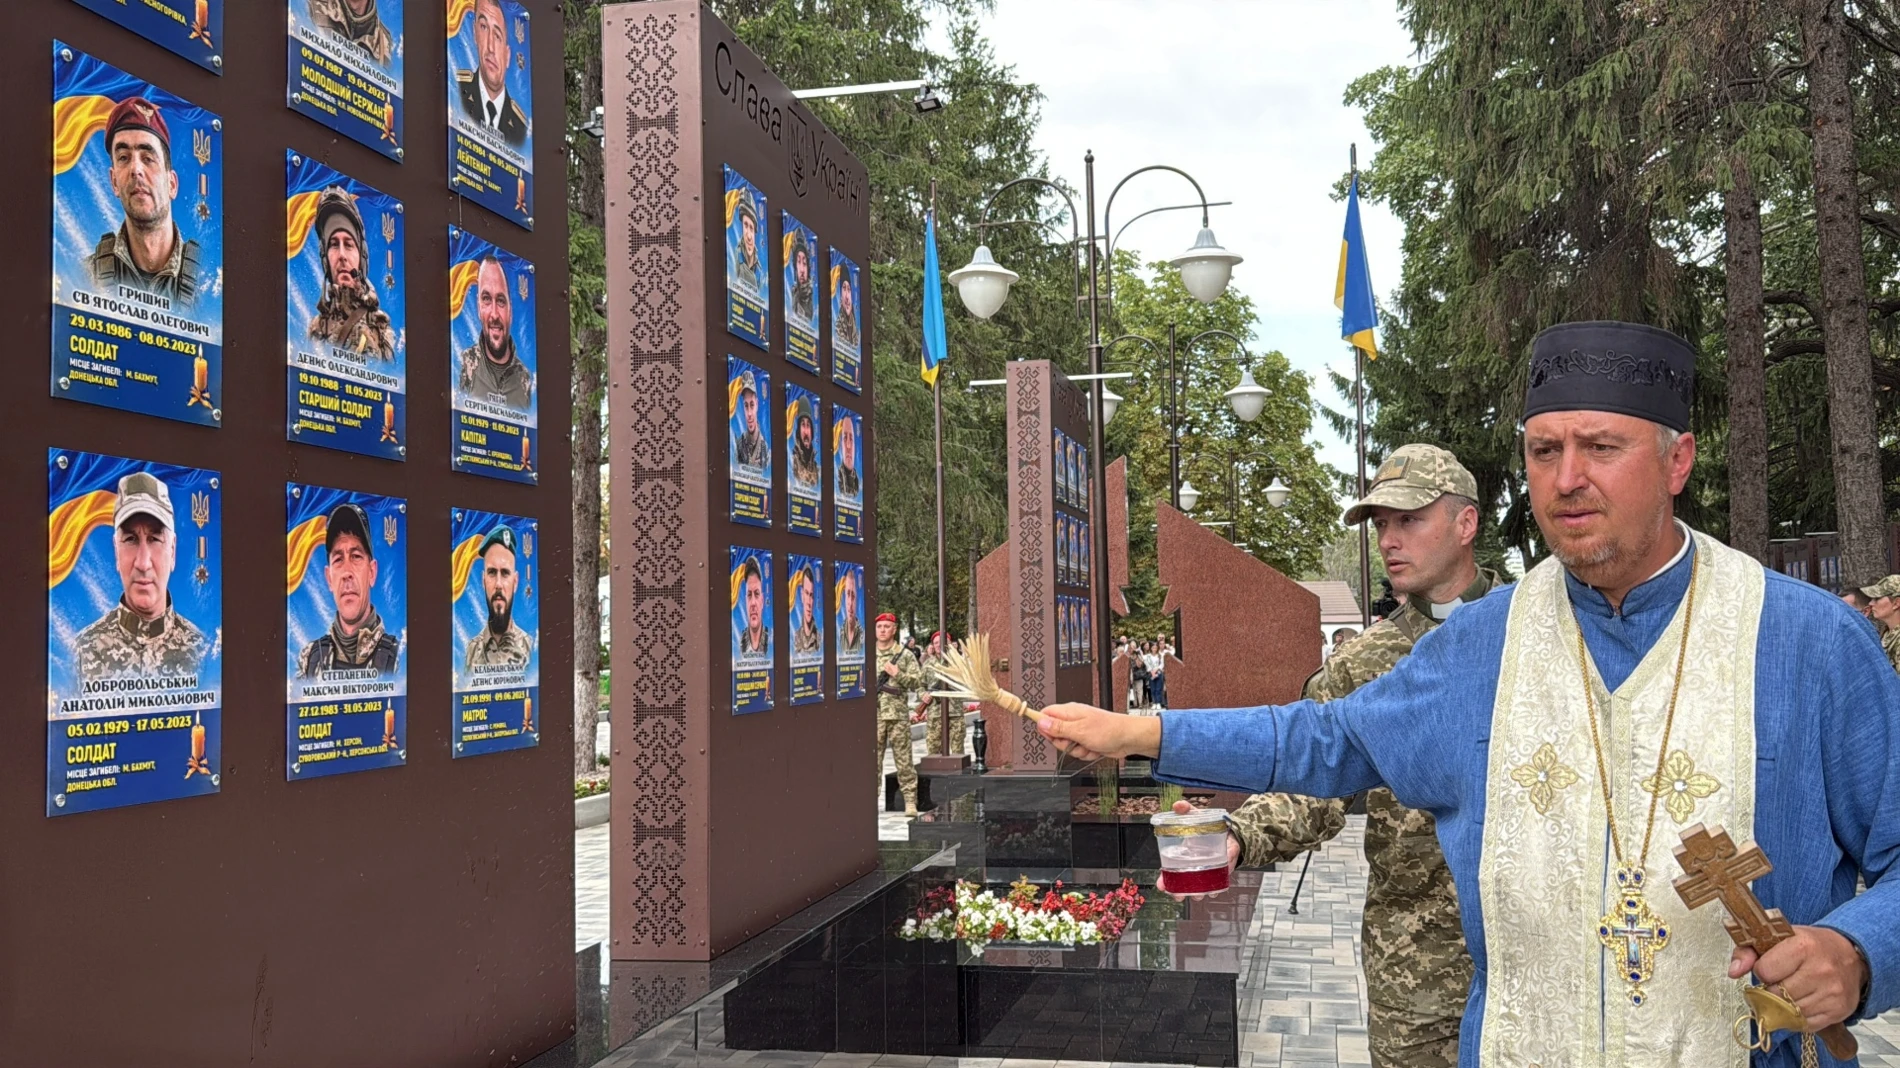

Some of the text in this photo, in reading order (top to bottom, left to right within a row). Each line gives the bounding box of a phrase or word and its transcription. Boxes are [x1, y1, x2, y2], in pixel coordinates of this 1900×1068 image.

[332, 32, 370, 61] КРАВЧУК
[301, 27, 397, 90] МИХАЙЛО МИХАЙЛОВИЧ
[301, 47, 343, 78] 09.07.1987
[348, 73, 385, 102] 19.04.2023
[301, 64, 387, 120] МОЛОДШИЙ СЕРЖАНТ
[458, 120, 486, 142] МАКСИМ
[715, 41, 862, 217] Слава Україні
[457, 149, 492, 178] ЛЕЙТЕНАНТ
[119, 286, 170, 310] ГРИШИН
[69, 314, 132, 340] 29.03.1986
[139, 332, 197, 356] 08.05.2023
[151, 312, 210, 337] ОЛЕГОВИЧ
[70, 335, 119, 361] СОЛДАТ
[332, 348, 366, 366] КРИВИЙ
[69, 357, 159, 386] МІСЦЕ ЗАГИБЕЛІ: М. БАХМУТ,
[69, 370, 119, 388] ДОНЕЦЬКА ОБЛ.
[297, 353, 398, 388] ДЕНИС ОЛЕКСАНДРОВИЧ
[299, 372, 339, 391] 19.10.1988
[345, 384, 383, 402] 11.05.2023
[299, 390, 373, 419] СТАРШИЙ СОЛДАТ
[461, 430, 486, 446] КАПІТАН
[83, 676, 198, 694] ДОБРОВОЛЬСЬКИЙ
[321, 669, 378, 682] СТЕПАНЕНКО
[472, 678, 493, 688] ДЕНИС
[302, 682, 395, 697] МАКСИМ ВІКТОРОВИЧ
[60, 692, 215, 713] АНАТОЛІЙ МИКОЛАЙОВИЧ
[299, 704, 339, 718] 27.12.1983
[343, 701, 382, 714] 31.05.2023
[67, 720, 130, 738] 05.02.1979
[136, 715, 192, 732] 17.05.2023
[462, 708, 488, 723] МАТРОС
[299, 722, 332, 740] СОЛДАТ
[67, 742, 117, 765] СОЛДАТ
[66, 760, 156, 780] МІСЦЕ ЗАГИБЕЛІ: М. БАХМУТ,
[66, 777, 118, 794] ДОНЕЦЬКА ОБЛ.
